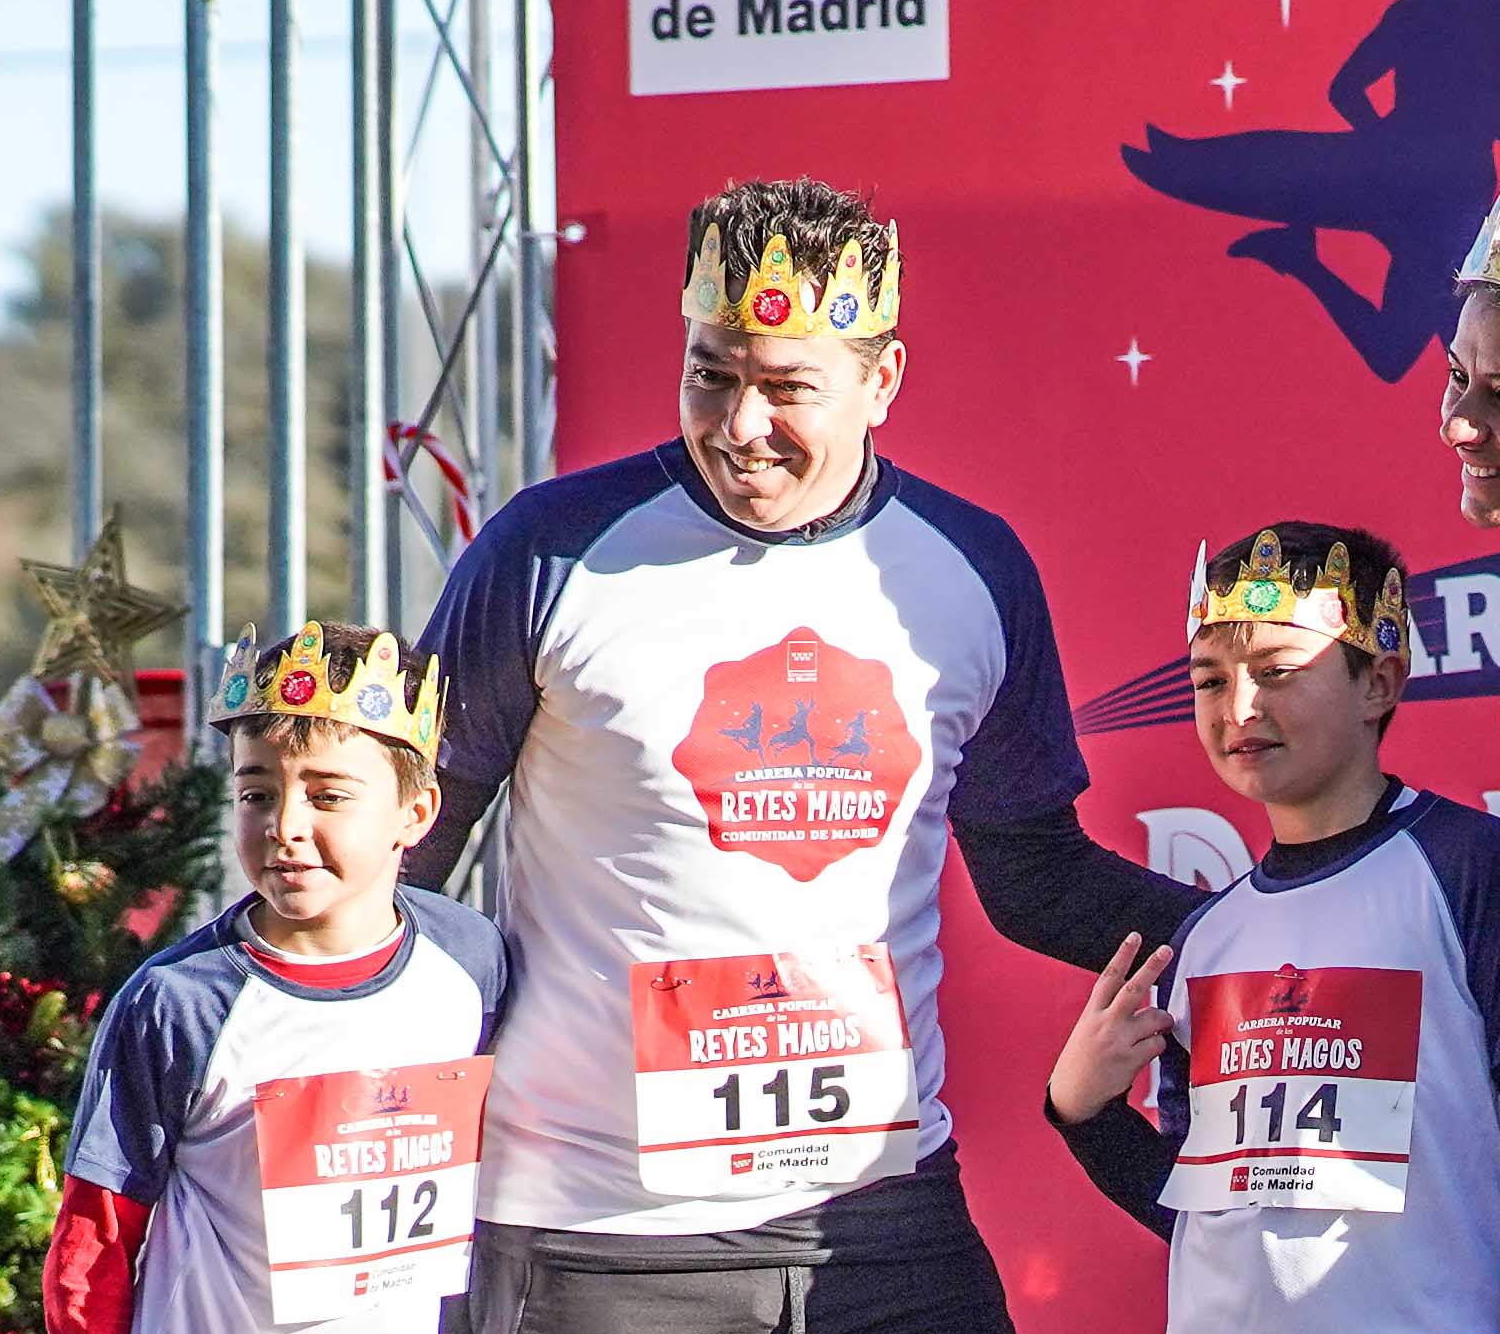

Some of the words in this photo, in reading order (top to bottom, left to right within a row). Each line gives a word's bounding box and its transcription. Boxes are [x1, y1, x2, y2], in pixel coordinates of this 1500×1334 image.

[734, 767, 804, 782] CARRERA
[807, 766, 873, 782] POPULAR
[720, 789, 798, 823] REYES
[807, 789, 887, 822] MAGOS
[720, 830, 806, 843] COMUNIDAD
[809, 829, 830, 841] DE
[831, 827, 879, 840] MADRID
[1237, 1017, 1285, 1032] CARRERA
[1288, 1016, 1342, 1030] POPULAR
[688, 1025, 769, 1063] REYES
[777, 1017, 861, 1057] MAGOS
[1220, 1038, 1275, 1075] REYES
[1281, 1037, 1363, 1070] MAGOS
[713, 1064, 850, 1131] 115
[1229, 1082, 1342, 1145] 114
[313, 1140, 387, 1178] REYES
[392, 1130, 454, 1172] MAGOS
[757, 1162, 774, 1171] de
[779, 1156, 829, 1168] Madrid
[758, 1144, 829, 1158] Comunidad
[1252, 1165, 1315, 1176] Comunidad
[1250, 1180, 1264, 1190] de
[1267, 1179, 1314, 1190] Madrid
[340, 1179, 438, 1249] 112
